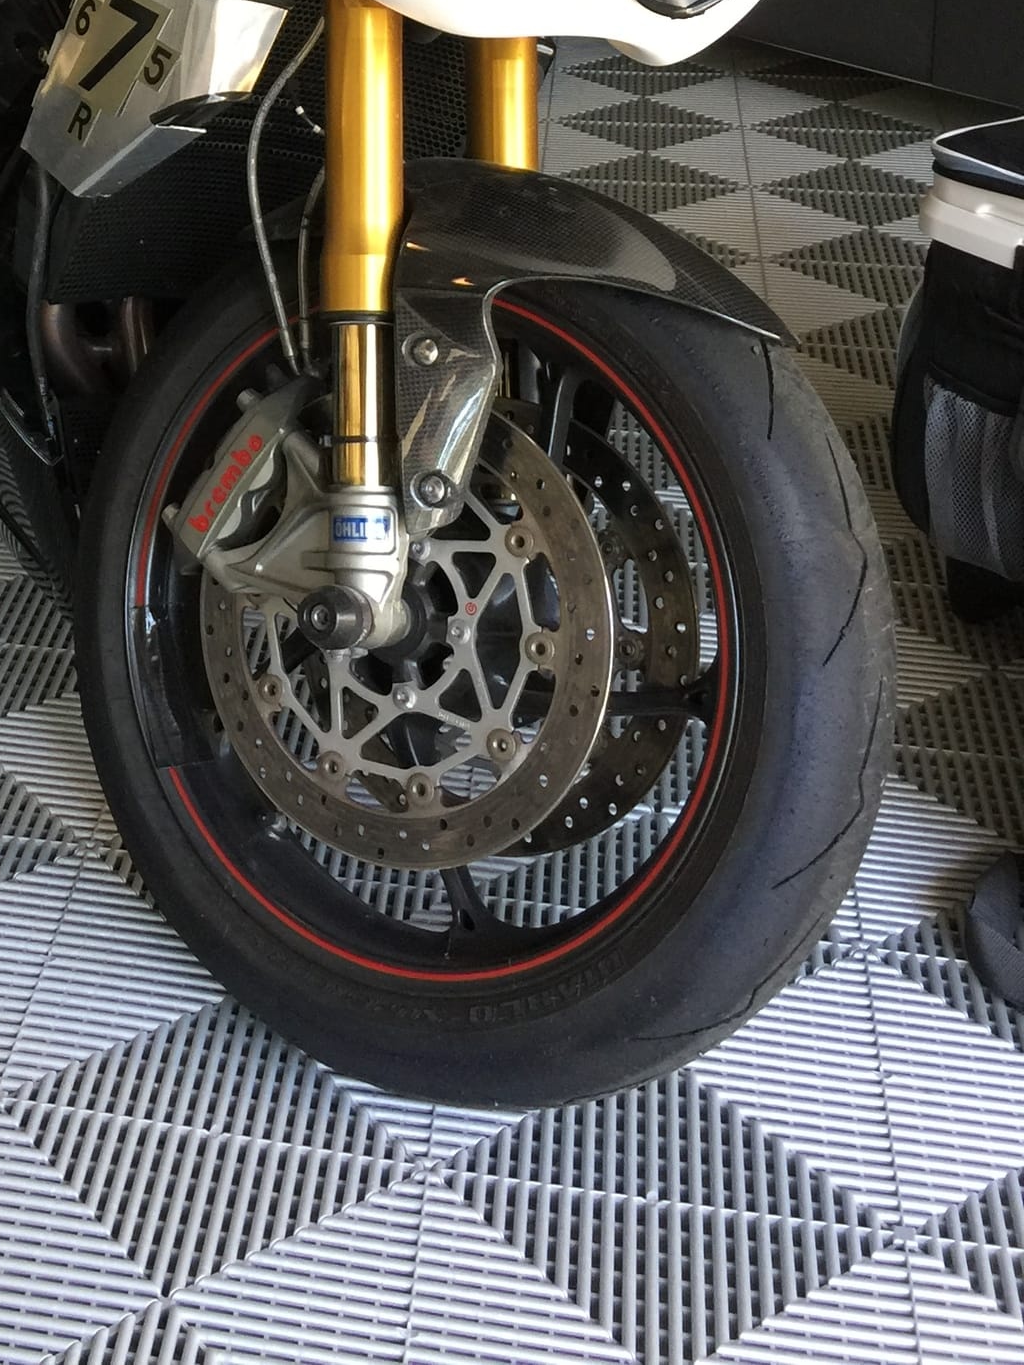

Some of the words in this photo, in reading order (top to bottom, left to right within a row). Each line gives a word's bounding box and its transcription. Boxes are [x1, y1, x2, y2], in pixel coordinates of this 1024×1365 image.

[75, 0, 96, 36] 6
[143, 45, 173, 86] 5
[67, 101, 92, 140] R
[187, 434, 264, 533] brembo
